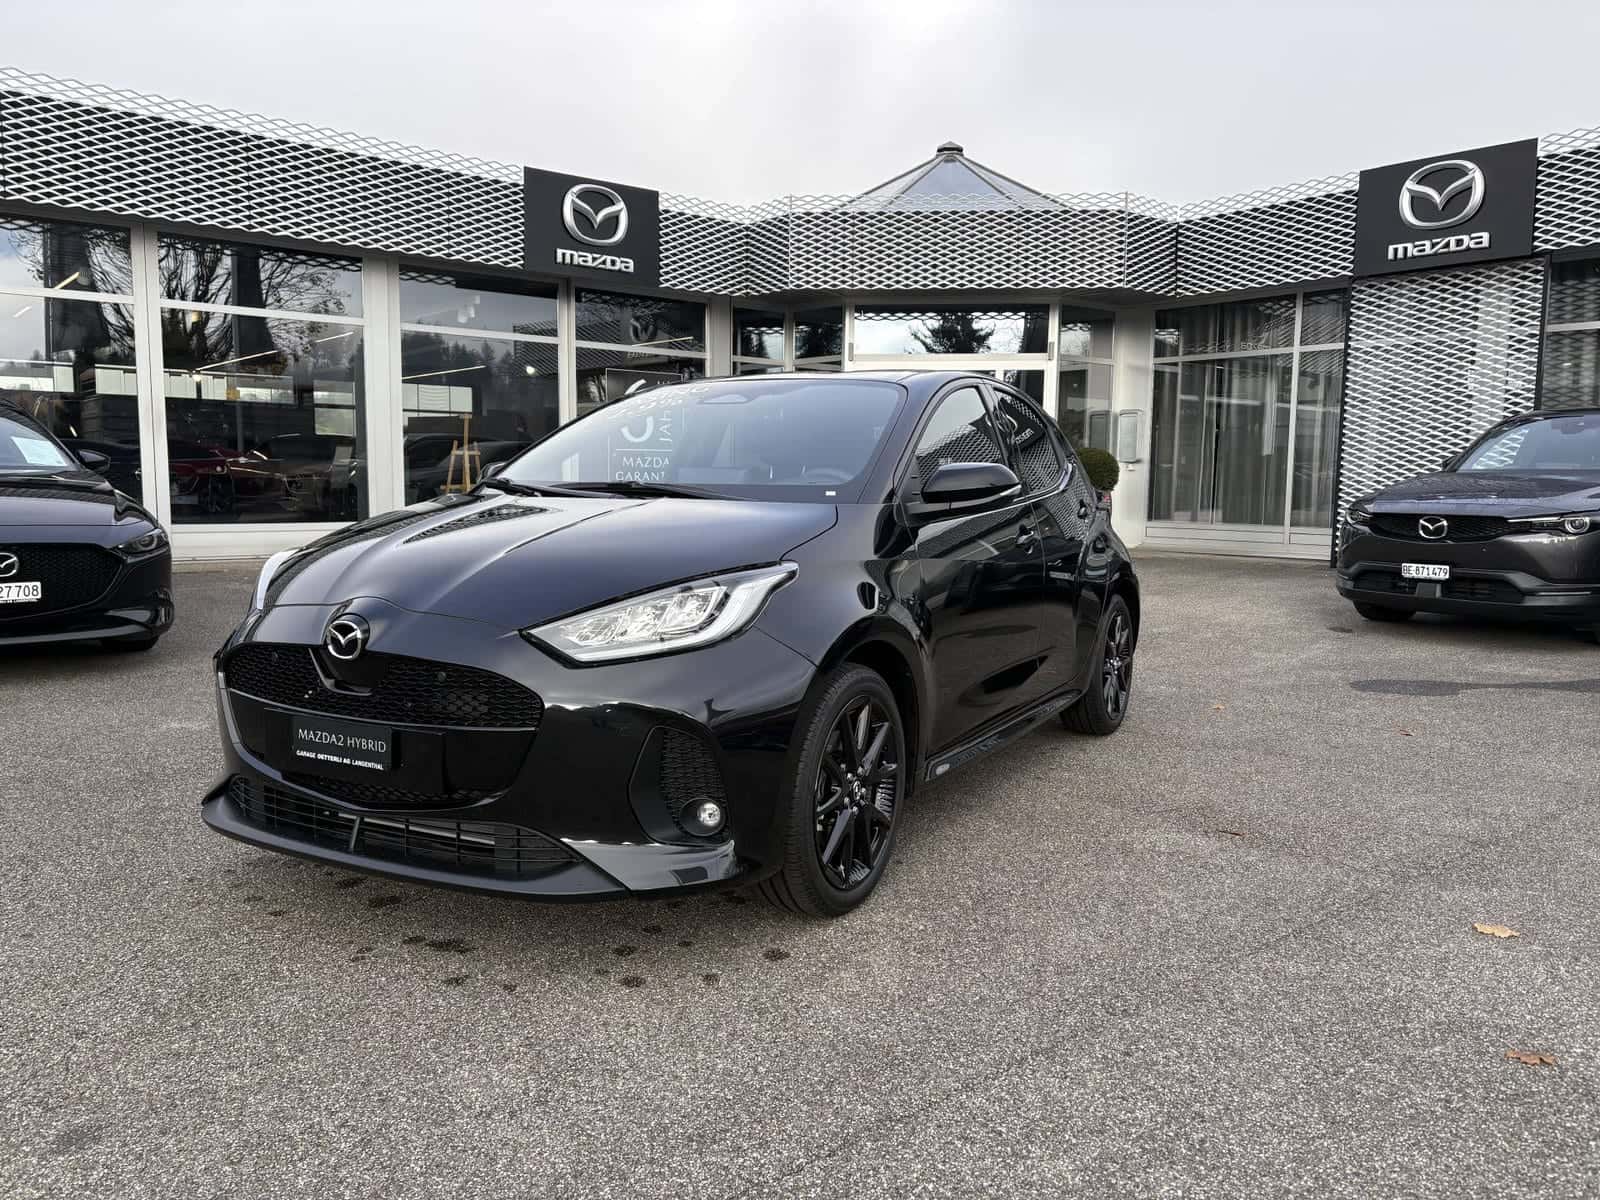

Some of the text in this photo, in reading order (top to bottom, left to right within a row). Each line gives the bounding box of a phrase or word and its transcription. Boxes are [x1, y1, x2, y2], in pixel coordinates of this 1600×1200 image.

[622, 456, 670, 468] MAZDA
[298, 728, 386, 753] MAZDA2 HYBRID
[295, 749, 316, 760] GARAGE
[316, 753, 342, 763] OETTERLI
[351, 759, 384, 771] LANGENTHAL
